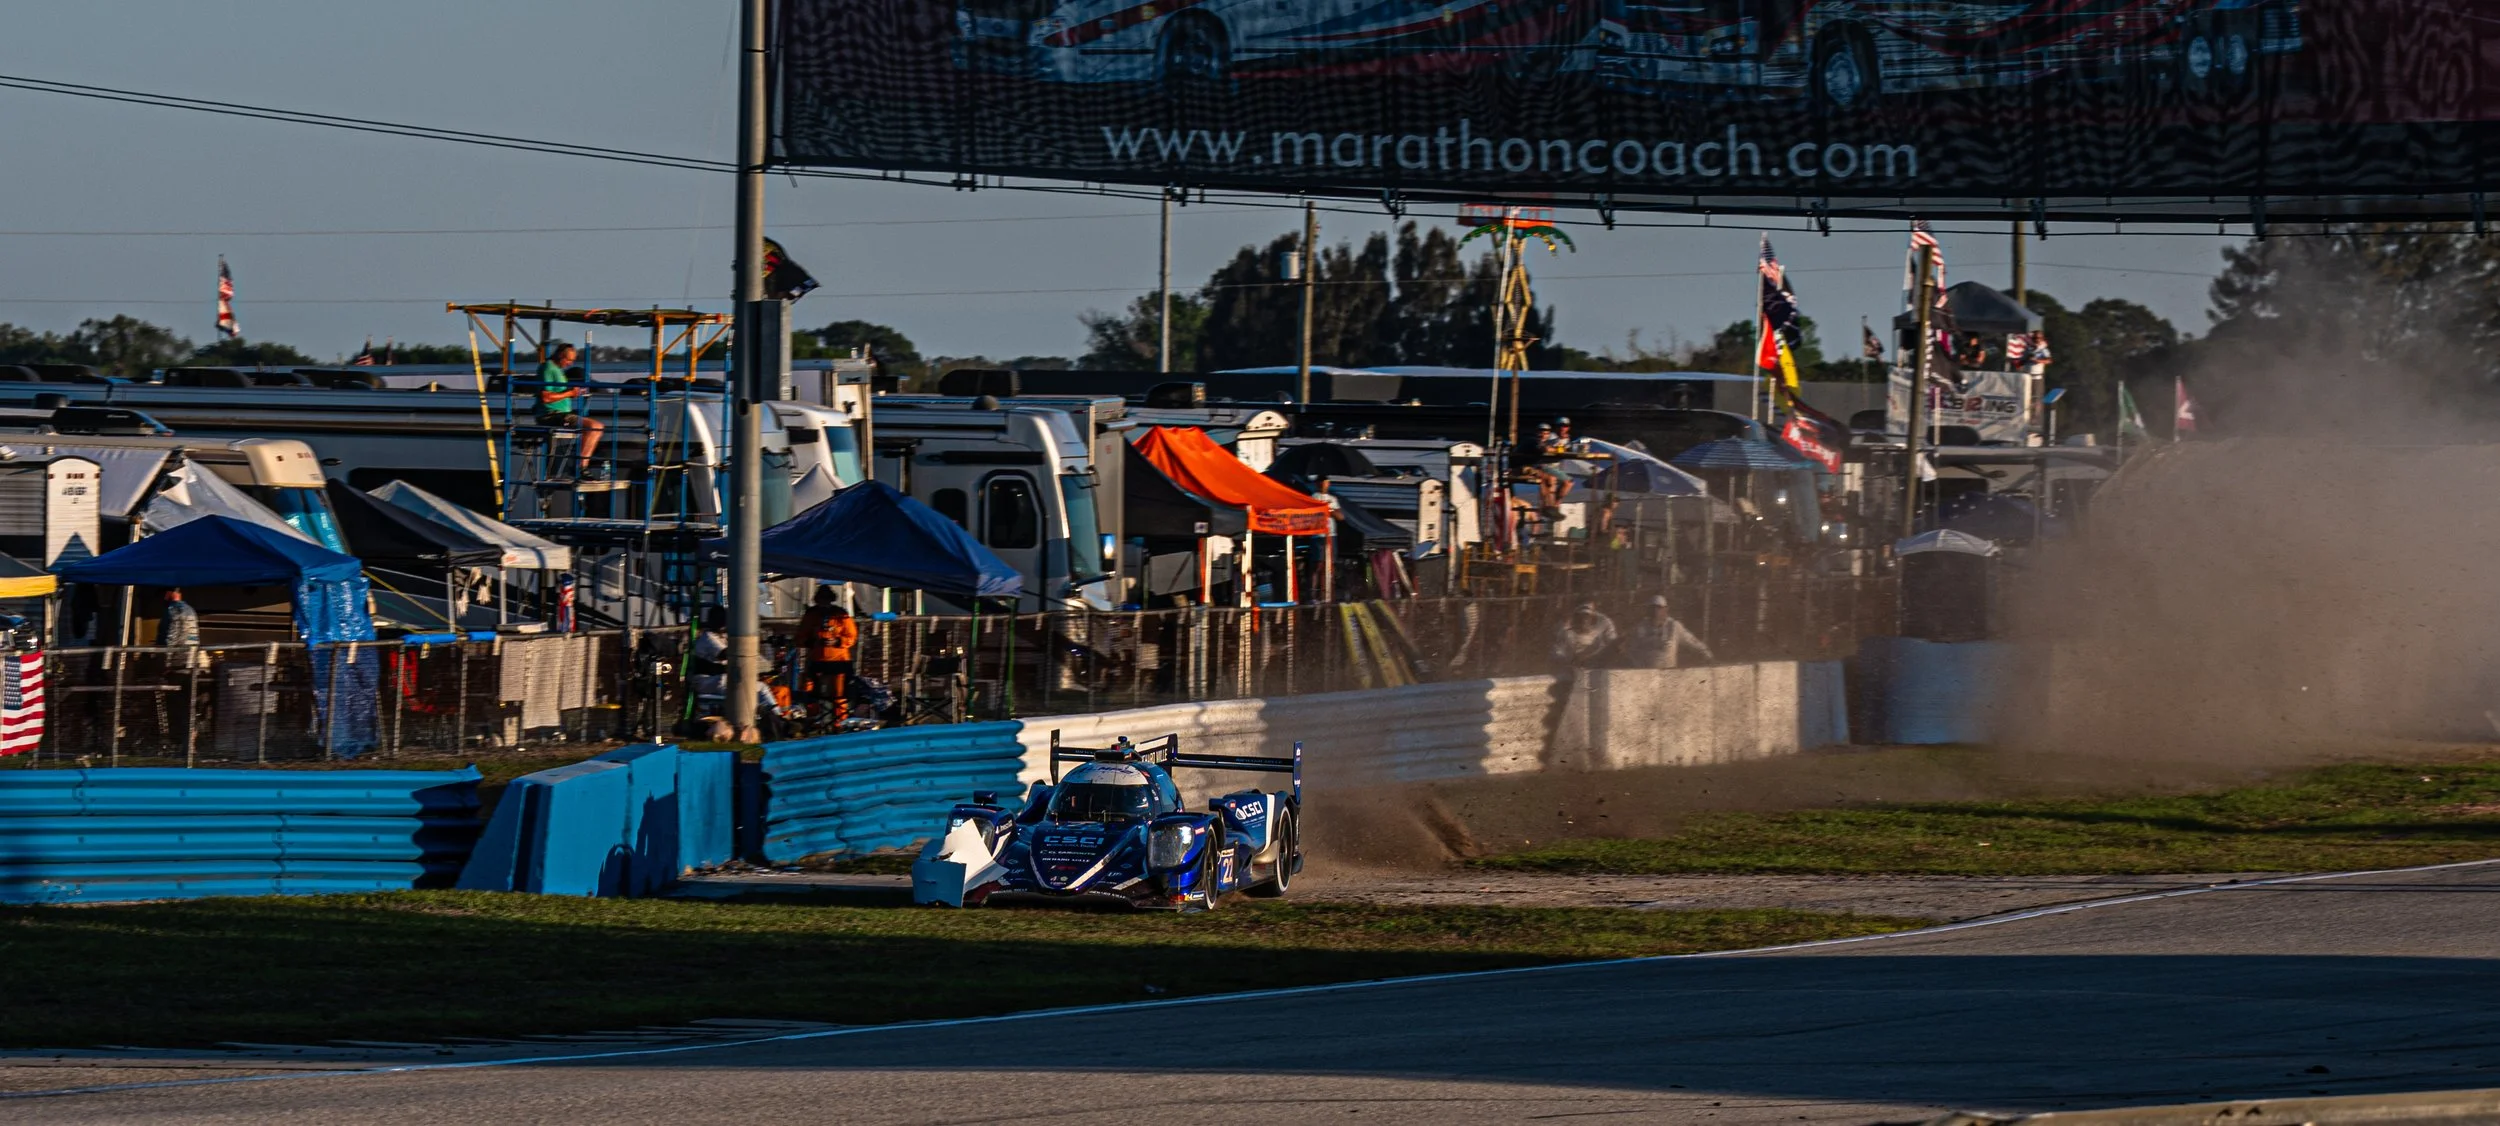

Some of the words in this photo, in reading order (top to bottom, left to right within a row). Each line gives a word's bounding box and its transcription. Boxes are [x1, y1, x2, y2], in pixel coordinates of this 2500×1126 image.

[1101, 119, 1917, 178] www.marathoncoach.com
[1242, 801, 1263, 817] CSCI
[1044, 835, 1104, 844] CSCI
